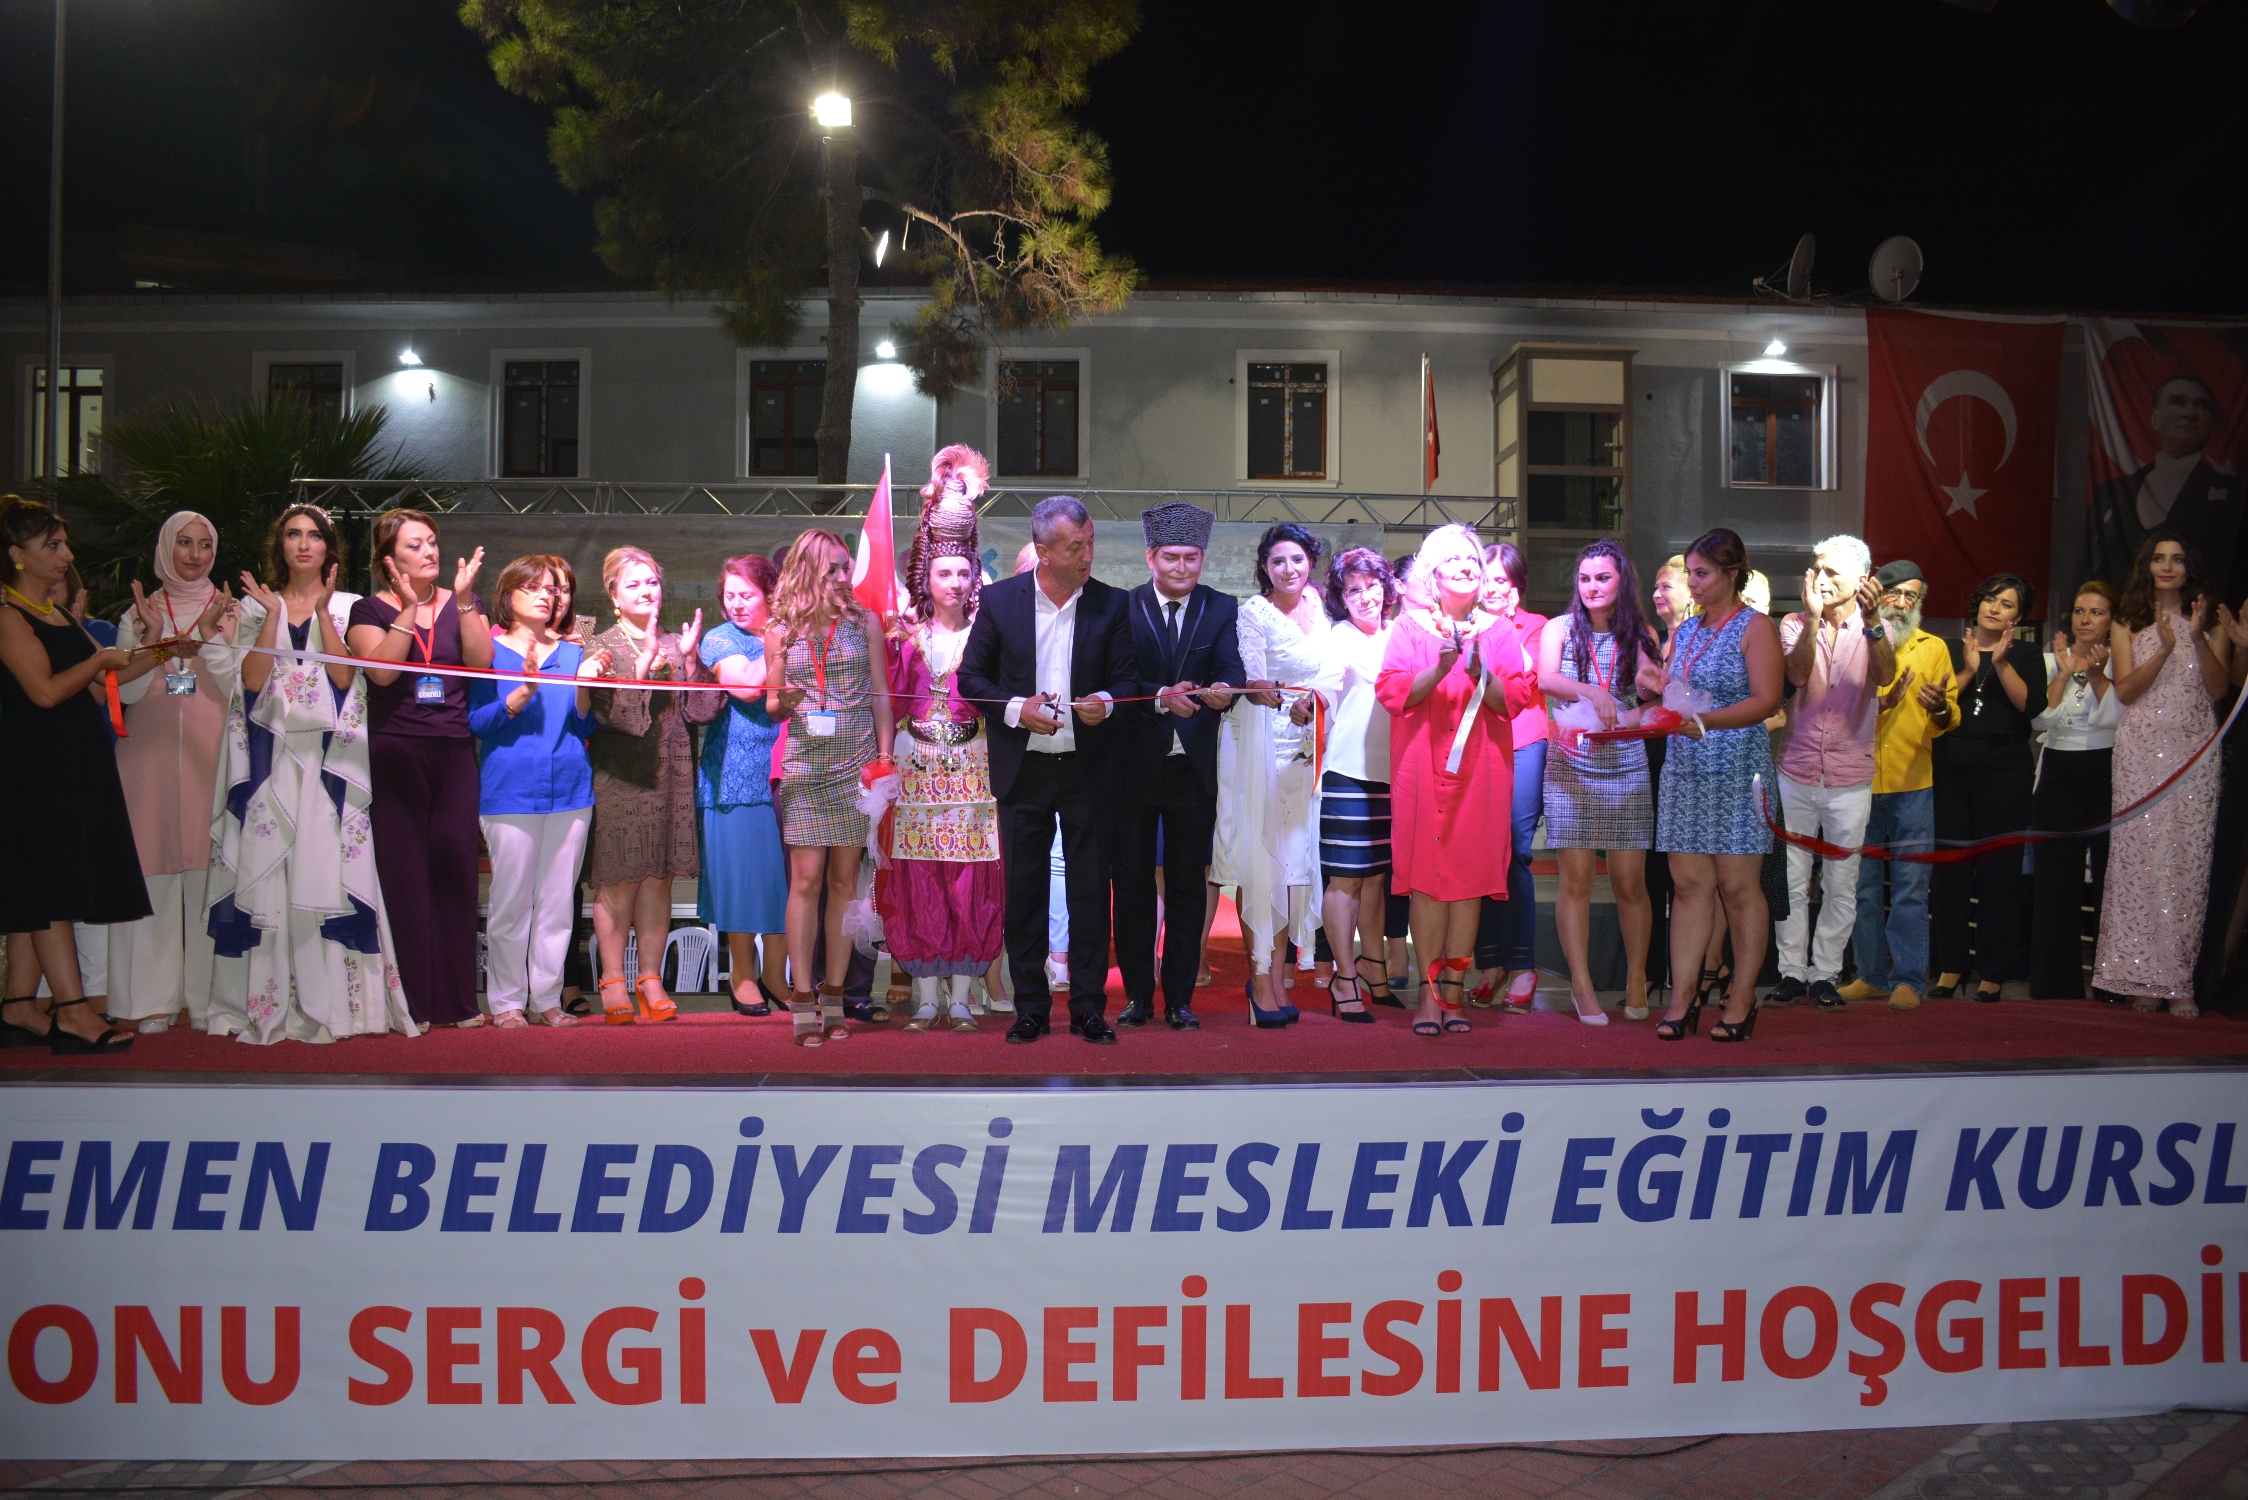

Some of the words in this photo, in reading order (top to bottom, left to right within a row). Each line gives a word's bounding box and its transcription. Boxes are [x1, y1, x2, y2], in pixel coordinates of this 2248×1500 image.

[0, 1140, 331, 1231] EMEN
[364, 1116, 1013, 1235] BELEDİYESİ
[1041, 1111, 1526, 1235] MESLEKİ
[1551, 1105, 1918, 1225] EĞİTİM
[1945, 1122, 2248, 1211] KURSL
[7, 1304, 302, 1406] ONU
[348, 1276, 707, 1406] SERGİ
[749, 1328, 902, 1405] ve
[949, 1269, 1631, 1404] DEFİLESİNE
[1673, 1245, 2248, 1407] HOŞGELDİ
